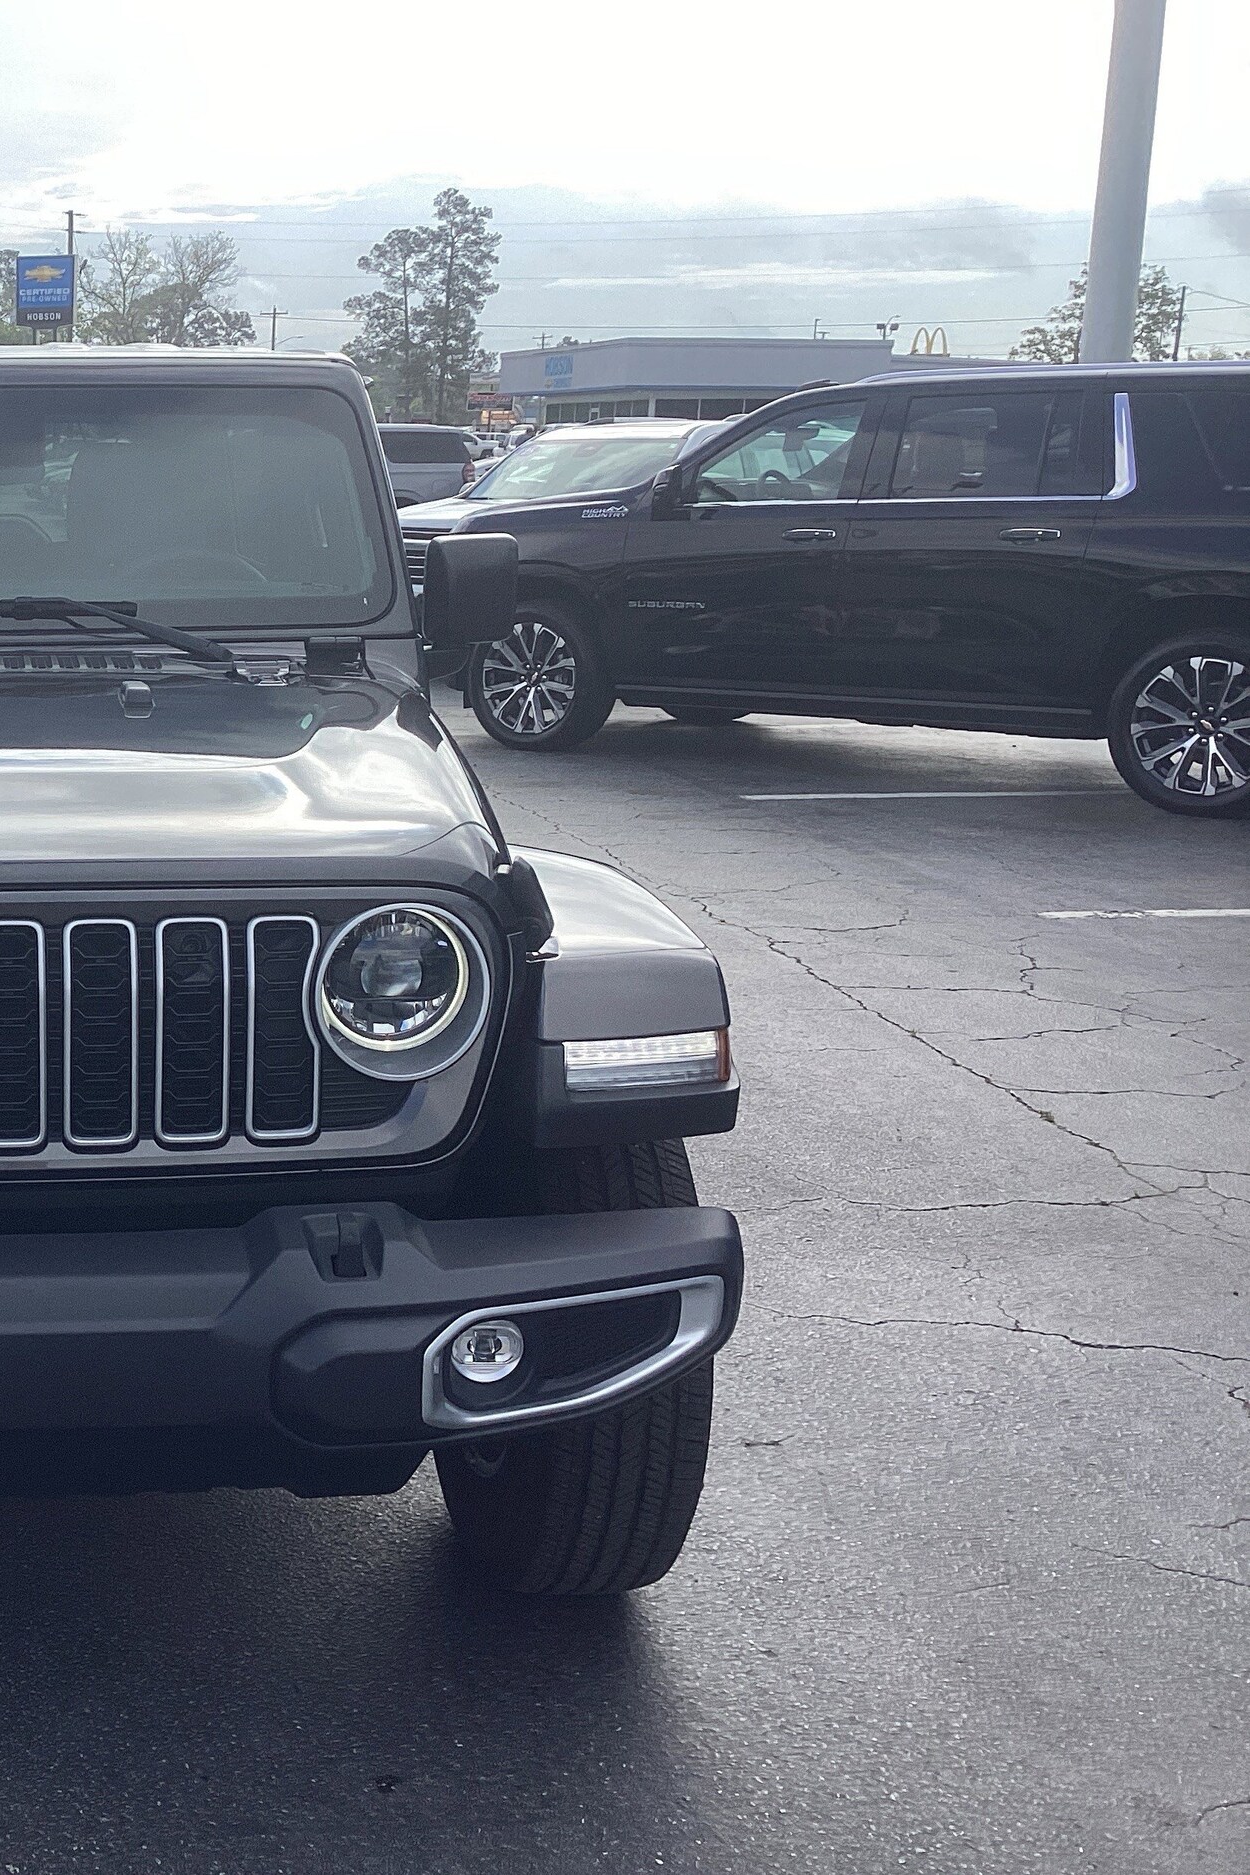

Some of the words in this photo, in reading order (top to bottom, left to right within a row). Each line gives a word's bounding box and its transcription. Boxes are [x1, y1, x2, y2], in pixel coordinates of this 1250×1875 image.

[19, 288, 70, 296] CERTIFIED
[26, 312, 61, 321] HOBSON
[628, 600, 706, 609] SUBURBAN
